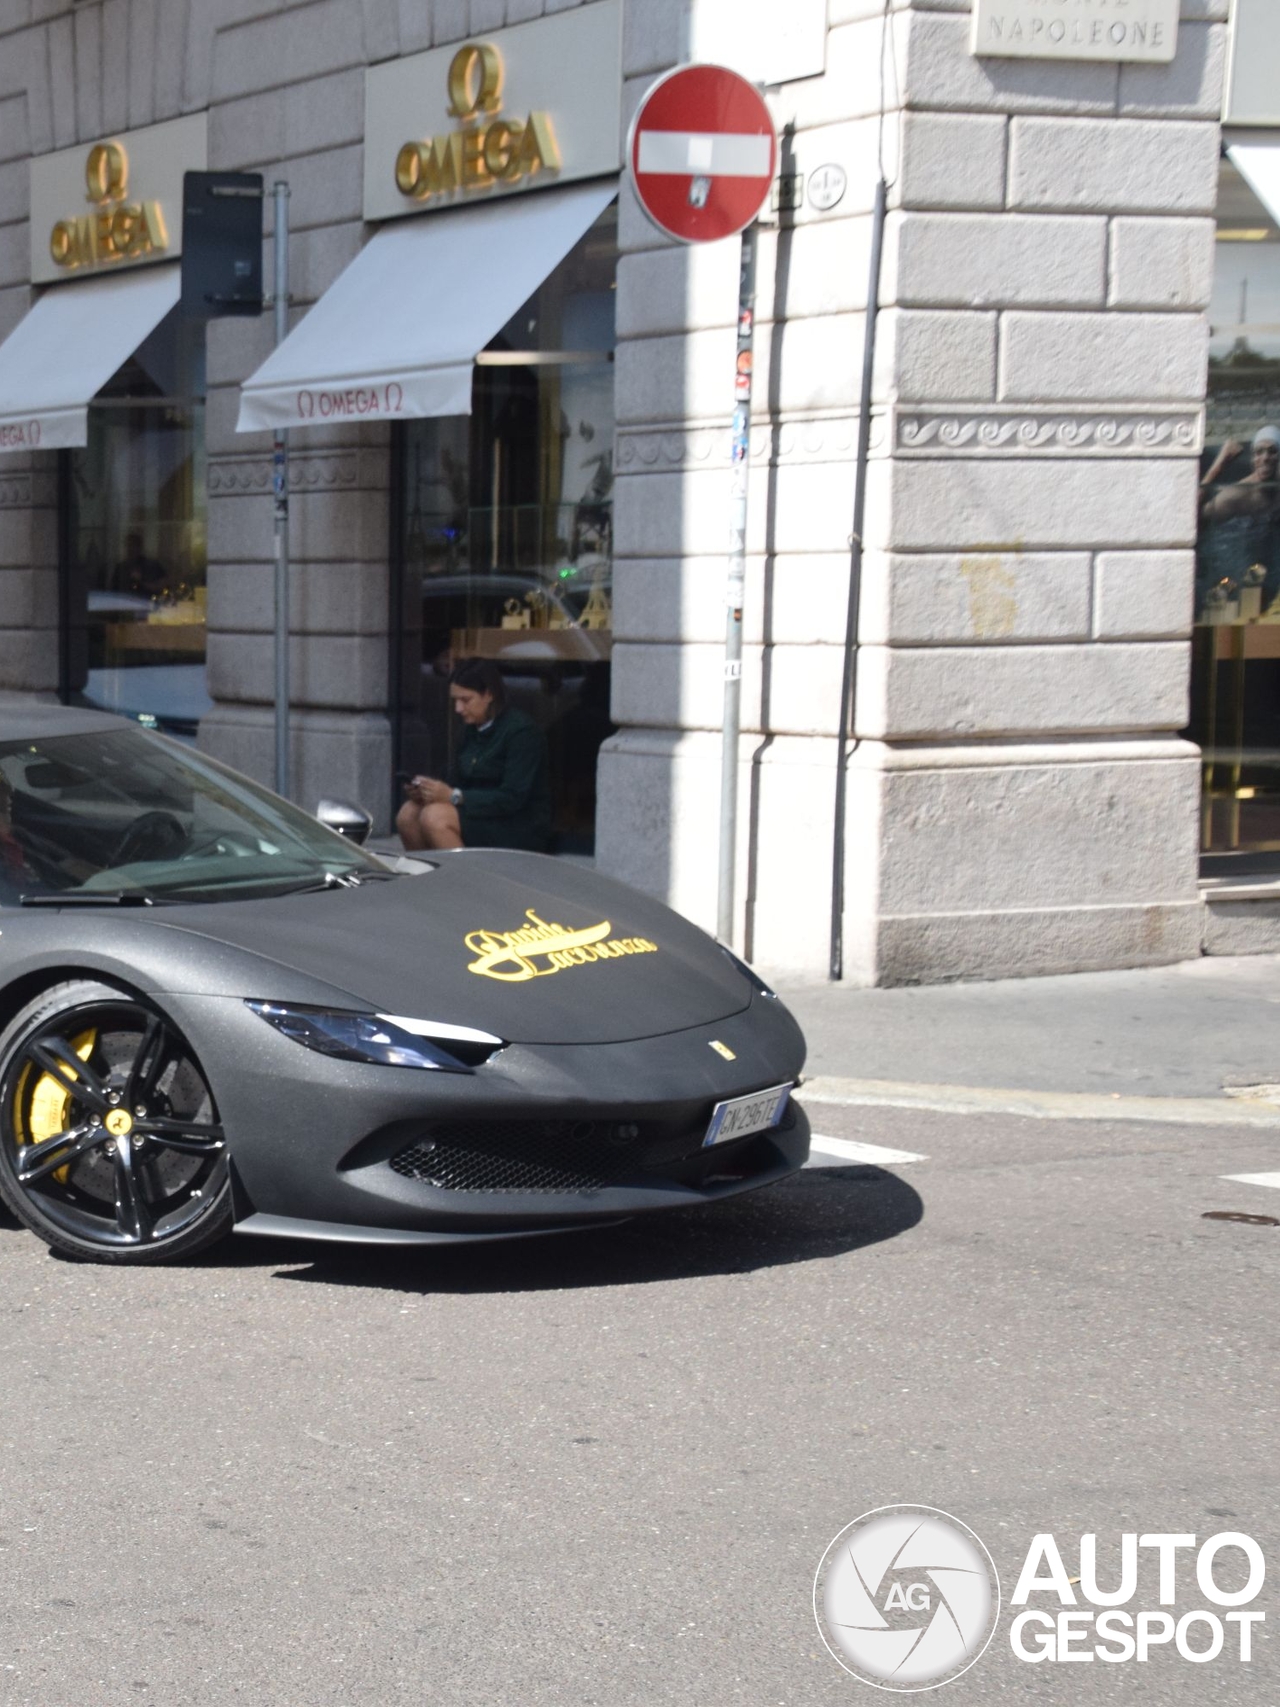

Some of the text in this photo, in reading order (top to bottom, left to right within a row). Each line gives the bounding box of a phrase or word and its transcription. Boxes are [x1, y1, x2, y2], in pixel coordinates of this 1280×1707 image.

[988, 15, 1165, 48] NAPOLEONE
[396, 110, 561, 198] OMEGA
[50, 200, 169, 267] OMEGA
[319, 389, 379, 416] OMEGA
[500, 936, 658, 980] Lacerenza
